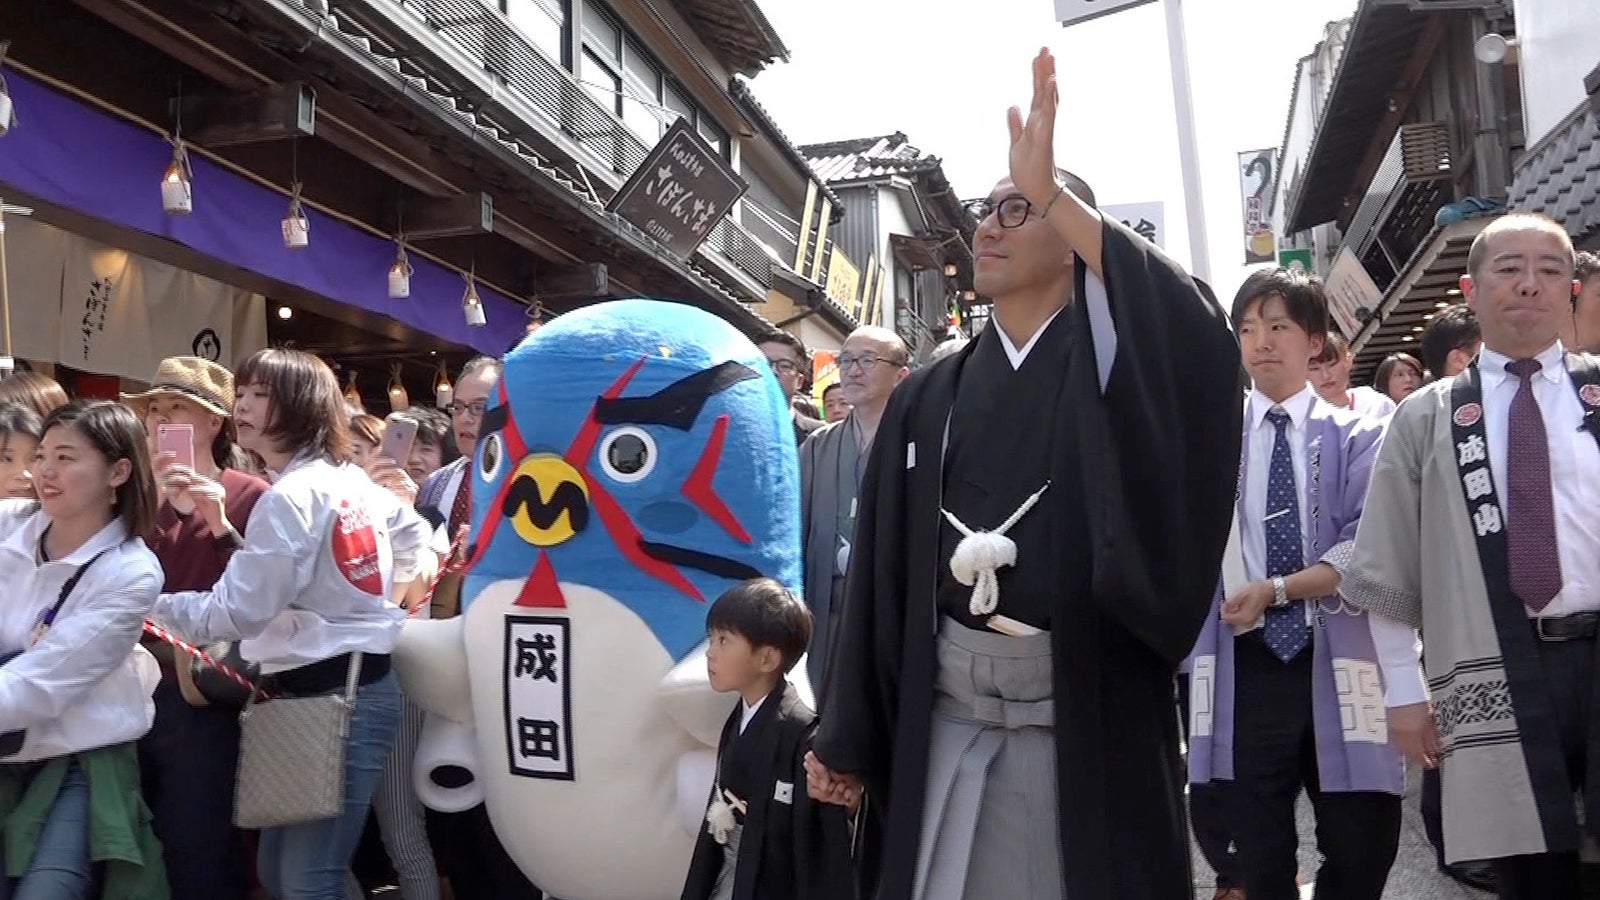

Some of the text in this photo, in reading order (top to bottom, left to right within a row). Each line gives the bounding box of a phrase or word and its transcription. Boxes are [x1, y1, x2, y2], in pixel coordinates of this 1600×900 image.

[1457, 434, 1501, 537] 成田山
[515, 633, 560, 762] 成田
